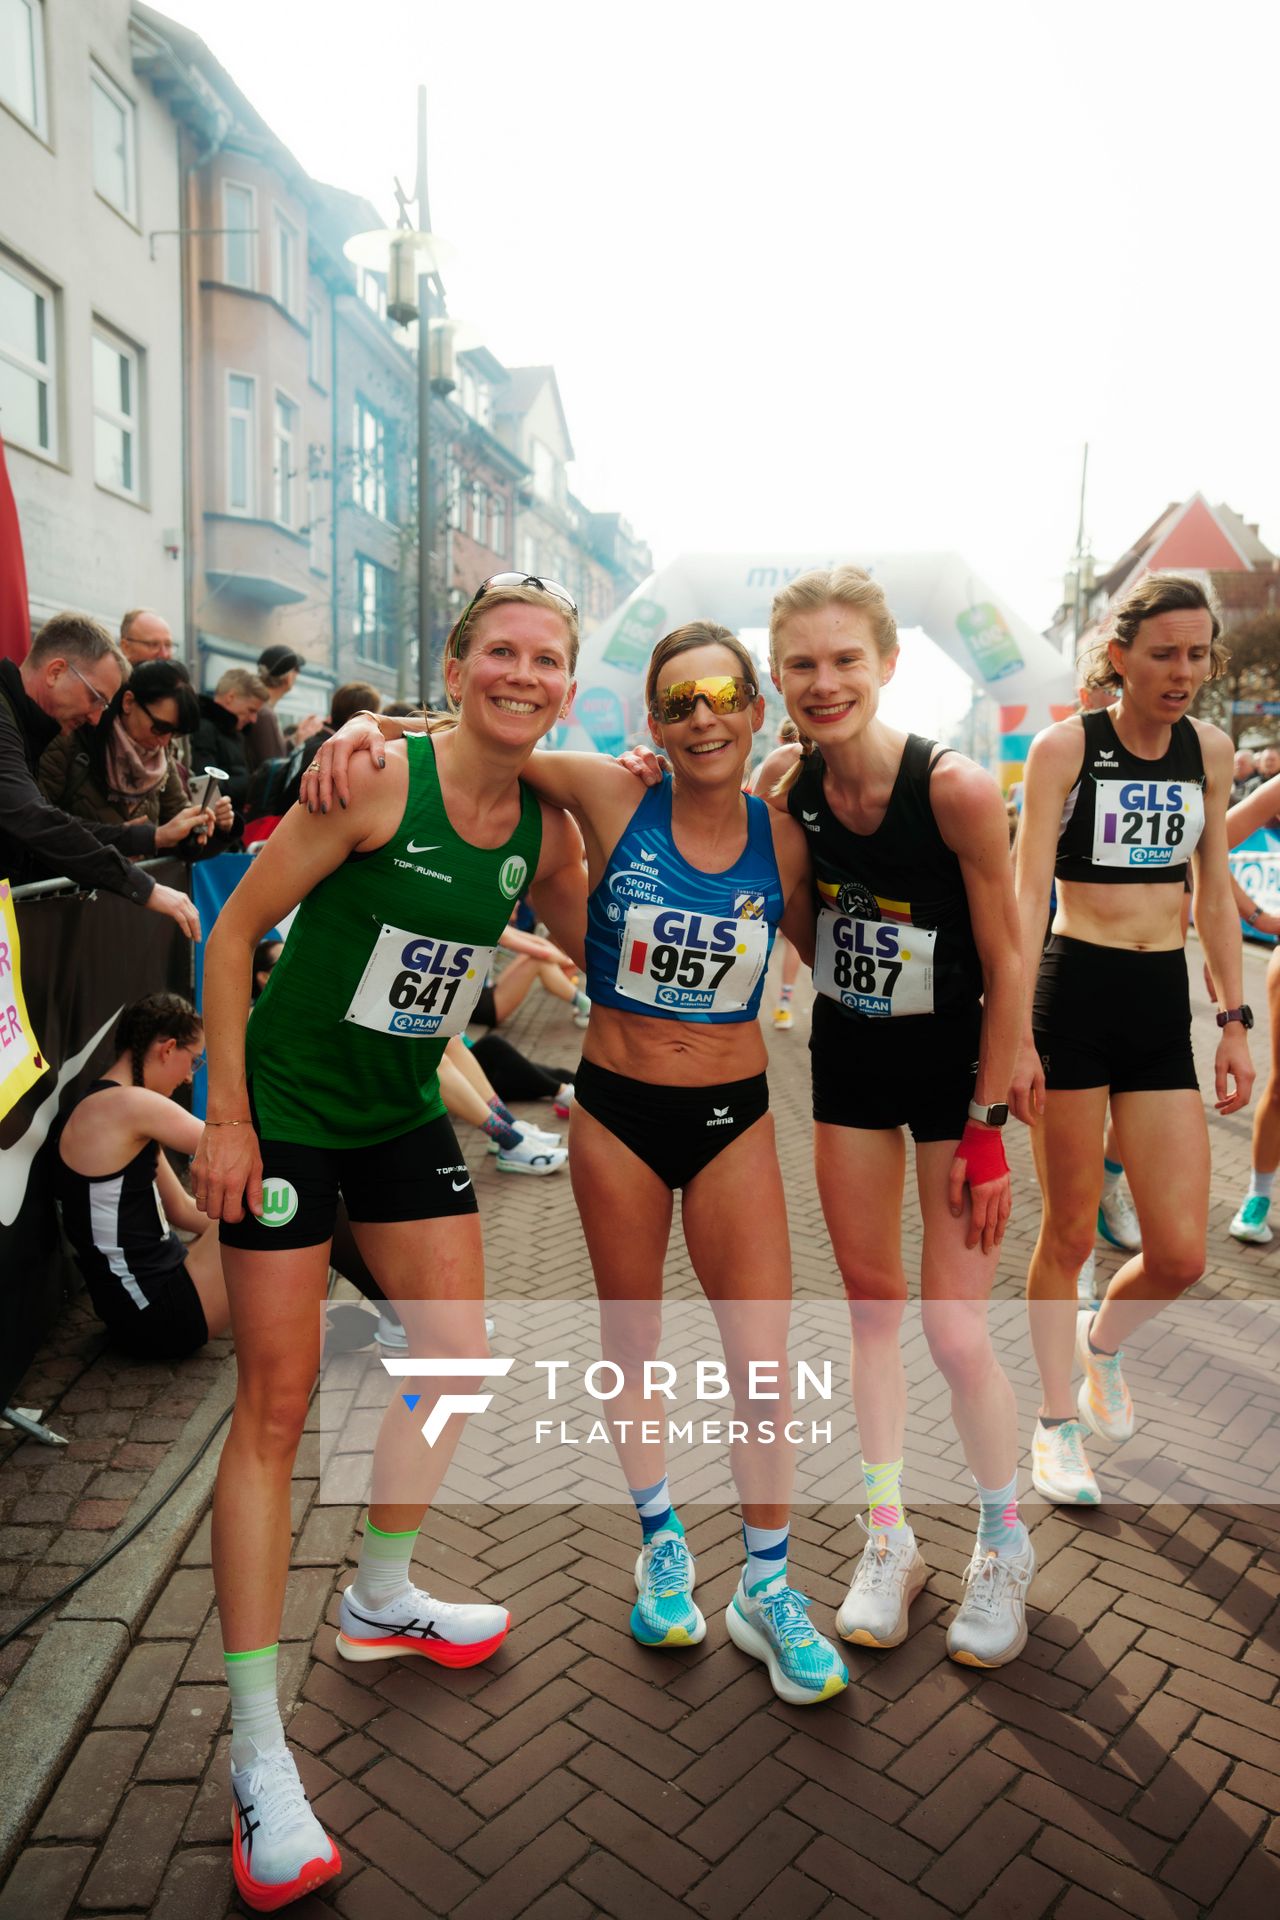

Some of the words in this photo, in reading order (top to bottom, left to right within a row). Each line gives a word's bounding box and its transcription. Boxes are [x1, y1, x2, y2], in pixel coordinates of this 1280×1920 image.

[1094, 760, 1119, 768] erima
[1121, 812, 1185, 846] 218
[1148, 850, 1172, 859] PLAN
[630, 861, 660, 876] erima
[625, 877, 658, 893] SPORT
[616, 885, 665, 905] KLAMSER
[650, 945, 737, 990] 957
[833, 950, 903, 998] 887
[388, 970, 462, 1016] 641
[680, 992, 713, 1003] PLAN
[858, 998, 889, 1012] PLAN
[413, 1017, 440, 1029] PLAN
[706, 1115, 733, 1126] erima
